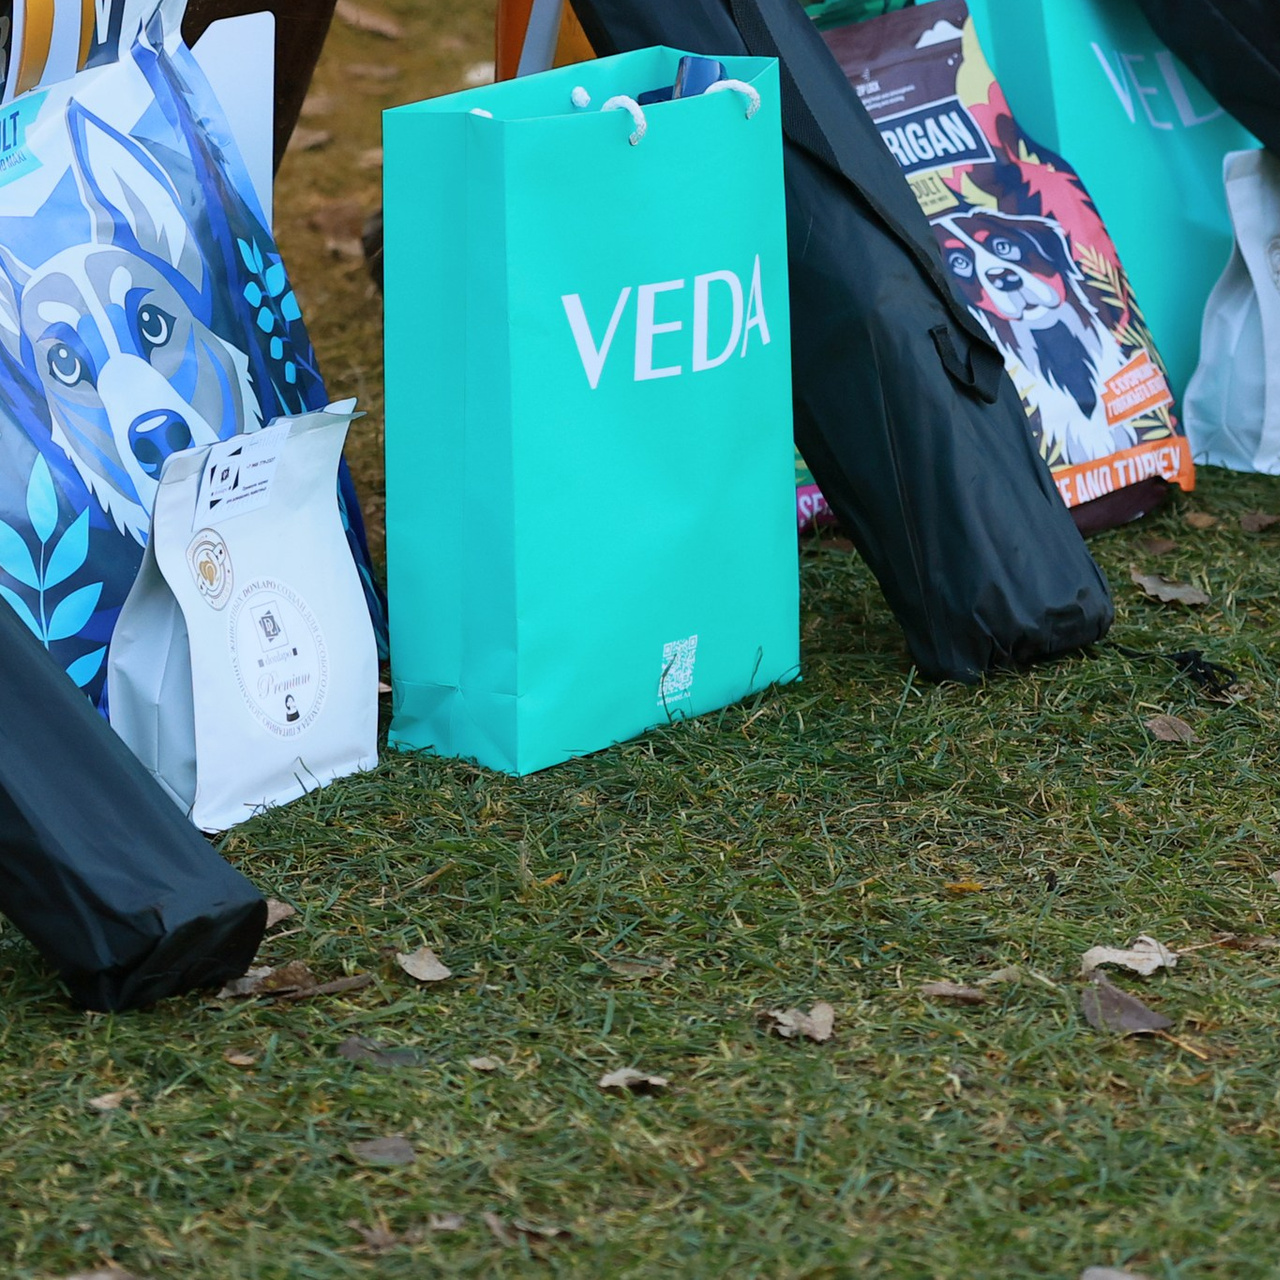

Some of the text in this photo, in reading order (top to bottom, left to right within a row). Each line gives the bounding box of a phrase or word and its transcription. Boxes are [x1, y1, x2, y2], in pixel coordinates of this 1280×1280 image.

[7, 150, 27, 171] MAXI
[561, 253, 771, 390] VEDA
[257, 671, 311, 699] Premium
